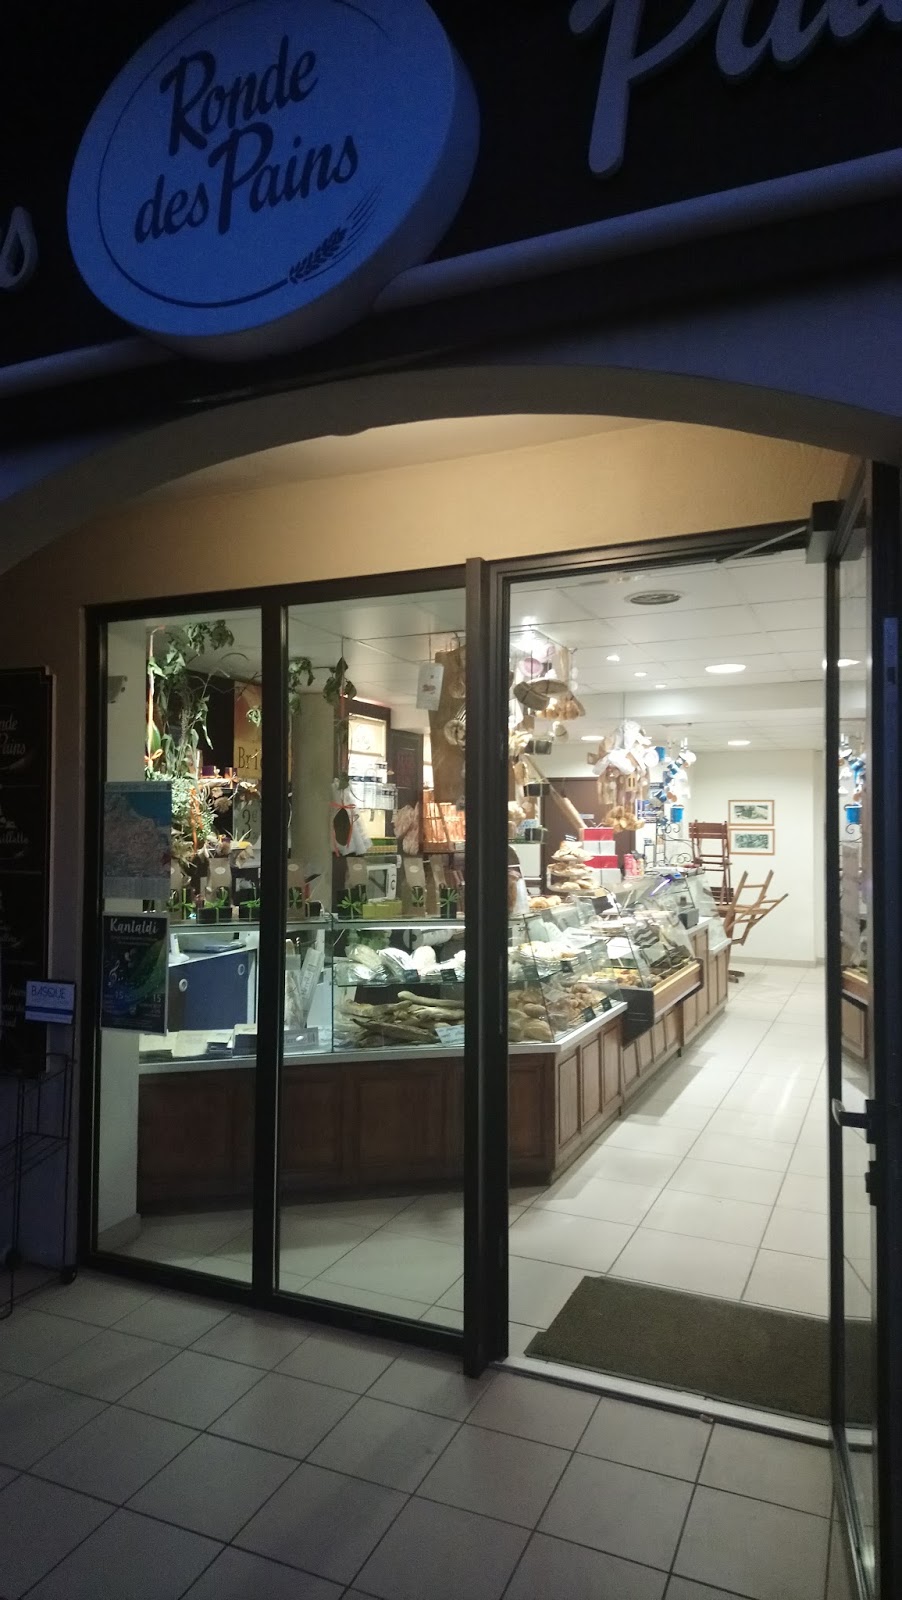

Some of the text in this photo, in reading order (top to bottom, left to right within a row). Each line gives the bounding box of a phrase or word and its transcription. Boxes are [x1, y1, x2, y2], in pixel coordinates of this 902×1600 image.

[160, 35, 319, 157] Ronde
[134, 121, 359, 244] des Pains
[238, 746, 262, 770] Bri
[31, 985, 66, 1000] BASQUE
